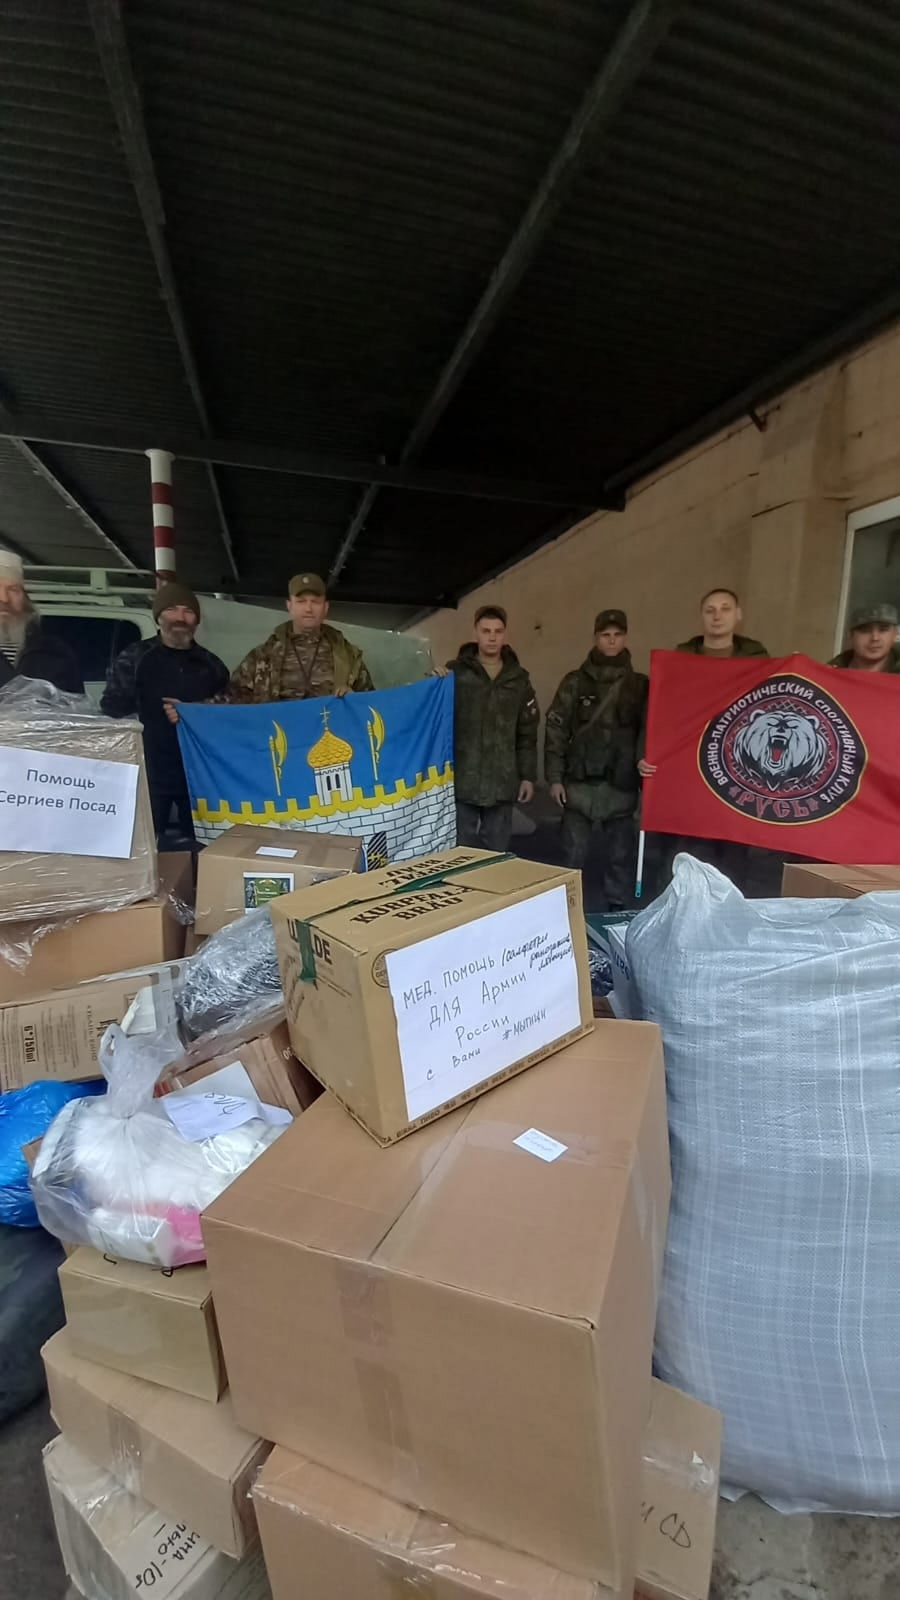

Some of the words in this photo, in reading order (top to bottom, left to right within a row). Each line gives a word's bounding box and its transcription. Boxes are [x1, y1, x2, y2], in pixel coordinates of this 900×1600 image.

[707, 682, 814, 786] ВОЕННО-ПАТРИОТИЧЕСКИЙ
[815, 699, 857, 775] СПОРТИВНЫЙ
[27, 768, 96, 790] Помощь
[819, 775, 852, 803] КЛУБ
[0, 790, 64, 808] Сергиев
[69, 798, 117, 815] Посад
[403, 980, 437, 1009] МЕД.
[443, 956, 495, 988] ПОМОЩЬ
[429, 996, 461, 1030] ДЛЯ
[482, 972, 526, 1005] Армии
[456, 1016, 509, 1048] России
